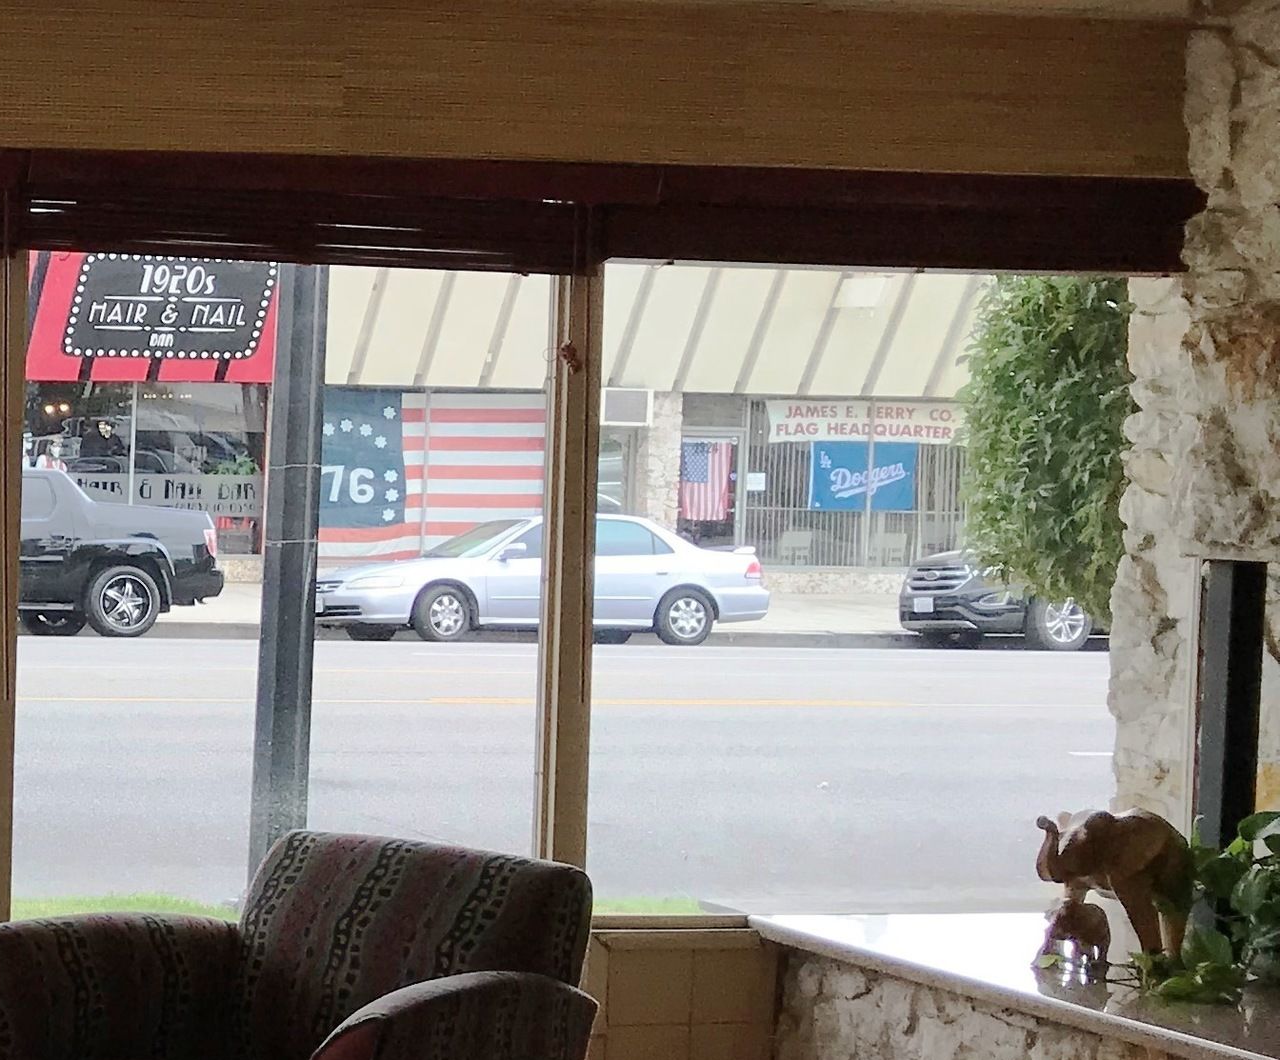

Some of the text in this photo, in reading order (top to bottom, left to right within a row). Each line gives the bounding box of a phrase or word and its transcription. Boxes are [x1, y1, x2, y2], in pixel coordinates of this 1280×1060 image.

[140, 265, 215, 294] 1920s
[89, 301, 246, 326] HAIR & NAIL
[149, 333, 174, 347] BAR
[785, 406, 838, 419] JAMES
[846, 406, 858, 419] E.
[929, 408, 956, 423] CO.
[776, 423, 819, 437] FLAG
[140, 478, 152, 499] &
[321, 465, 375, 504] 76
[830, 463, 907, 499] Dodgers
